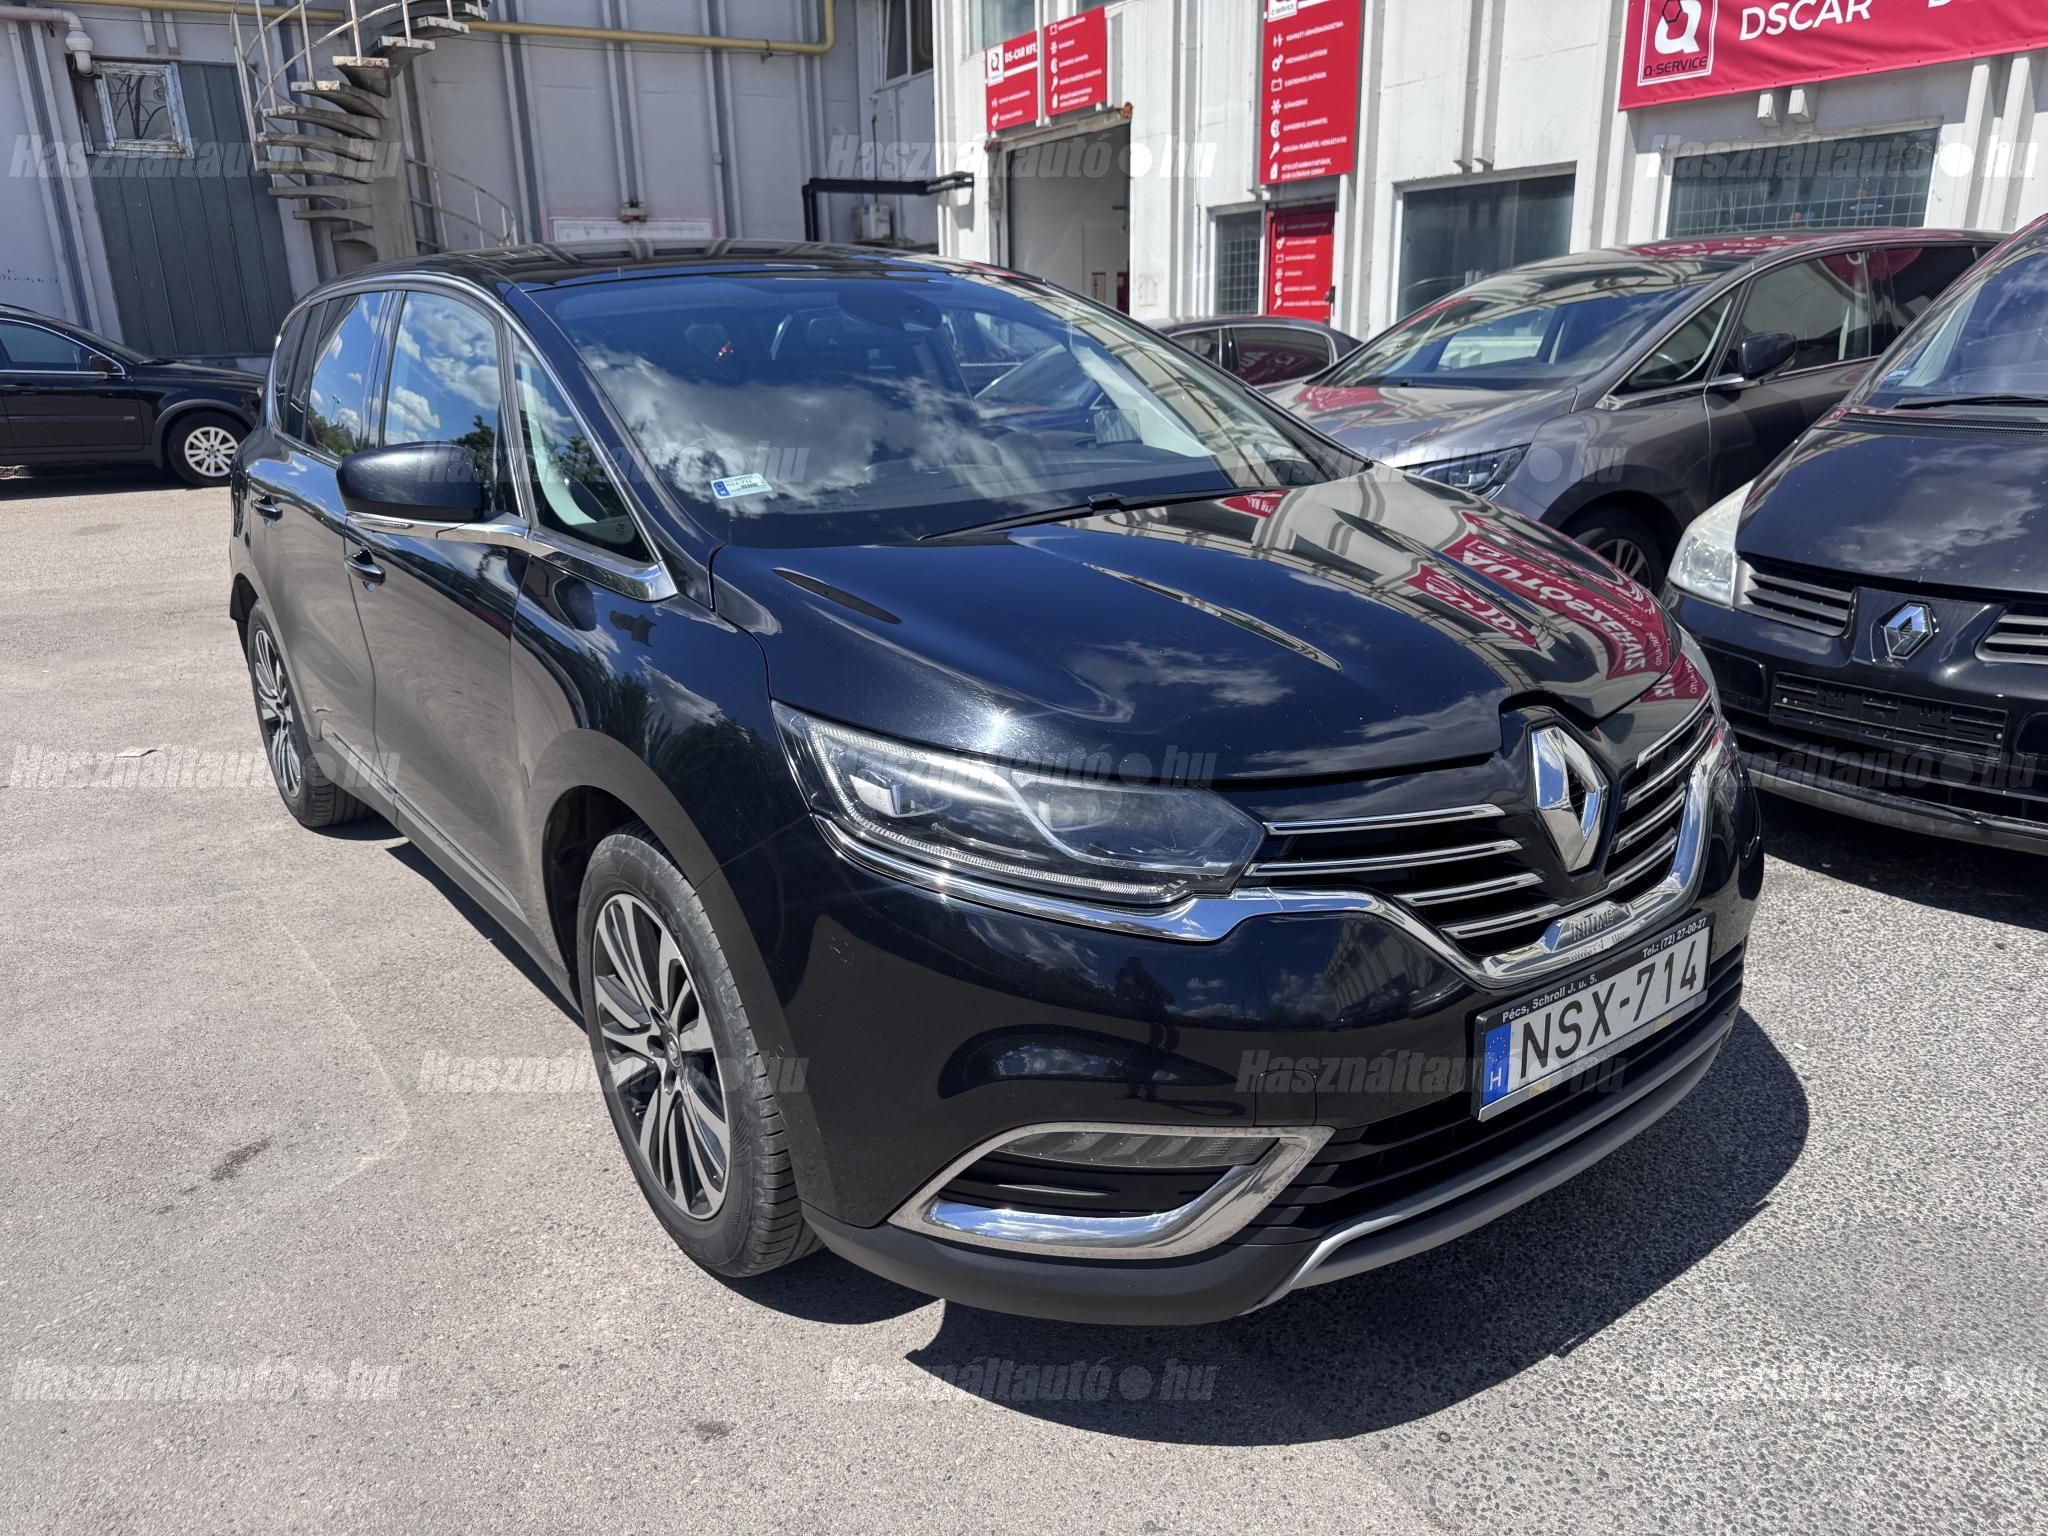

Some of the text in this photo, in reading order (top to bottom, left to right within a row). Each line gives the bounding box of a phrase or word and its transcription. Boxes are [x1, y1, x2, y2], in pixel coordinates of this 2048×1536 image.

[1739, 0, 1871, 40] DSCAR
[1502, 1006, 1530, 1023] Pécs,
[1520, 939, 1698, 1079] NSX-714
[1488, 1067, 1503, 1092] H
